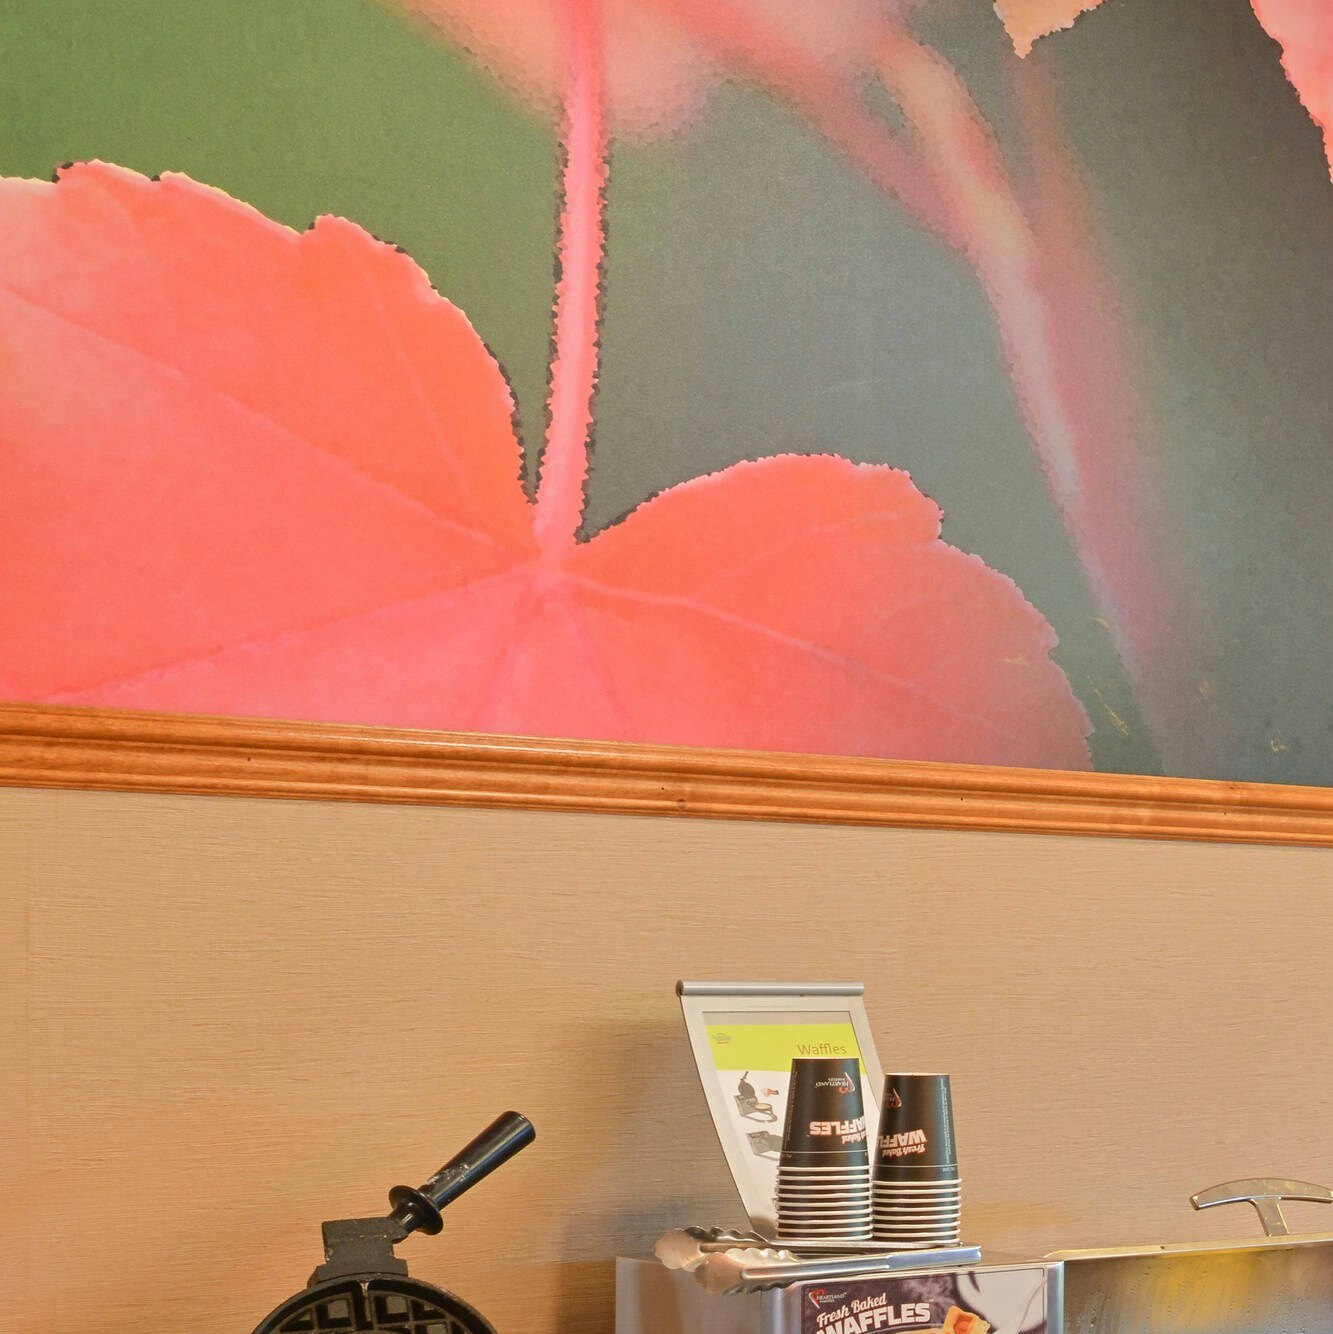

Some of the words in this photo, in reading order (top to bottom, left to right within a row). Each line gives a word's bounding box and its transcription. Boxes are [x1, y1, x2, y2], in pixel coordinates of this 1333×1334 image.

[797, 1043, 847, 1055] Waffles
[903, 1144, 926, 1155] Fresh
[816, 1304, 850, 1327] Fresh
[851, 1293, 887, 1314] Baked
